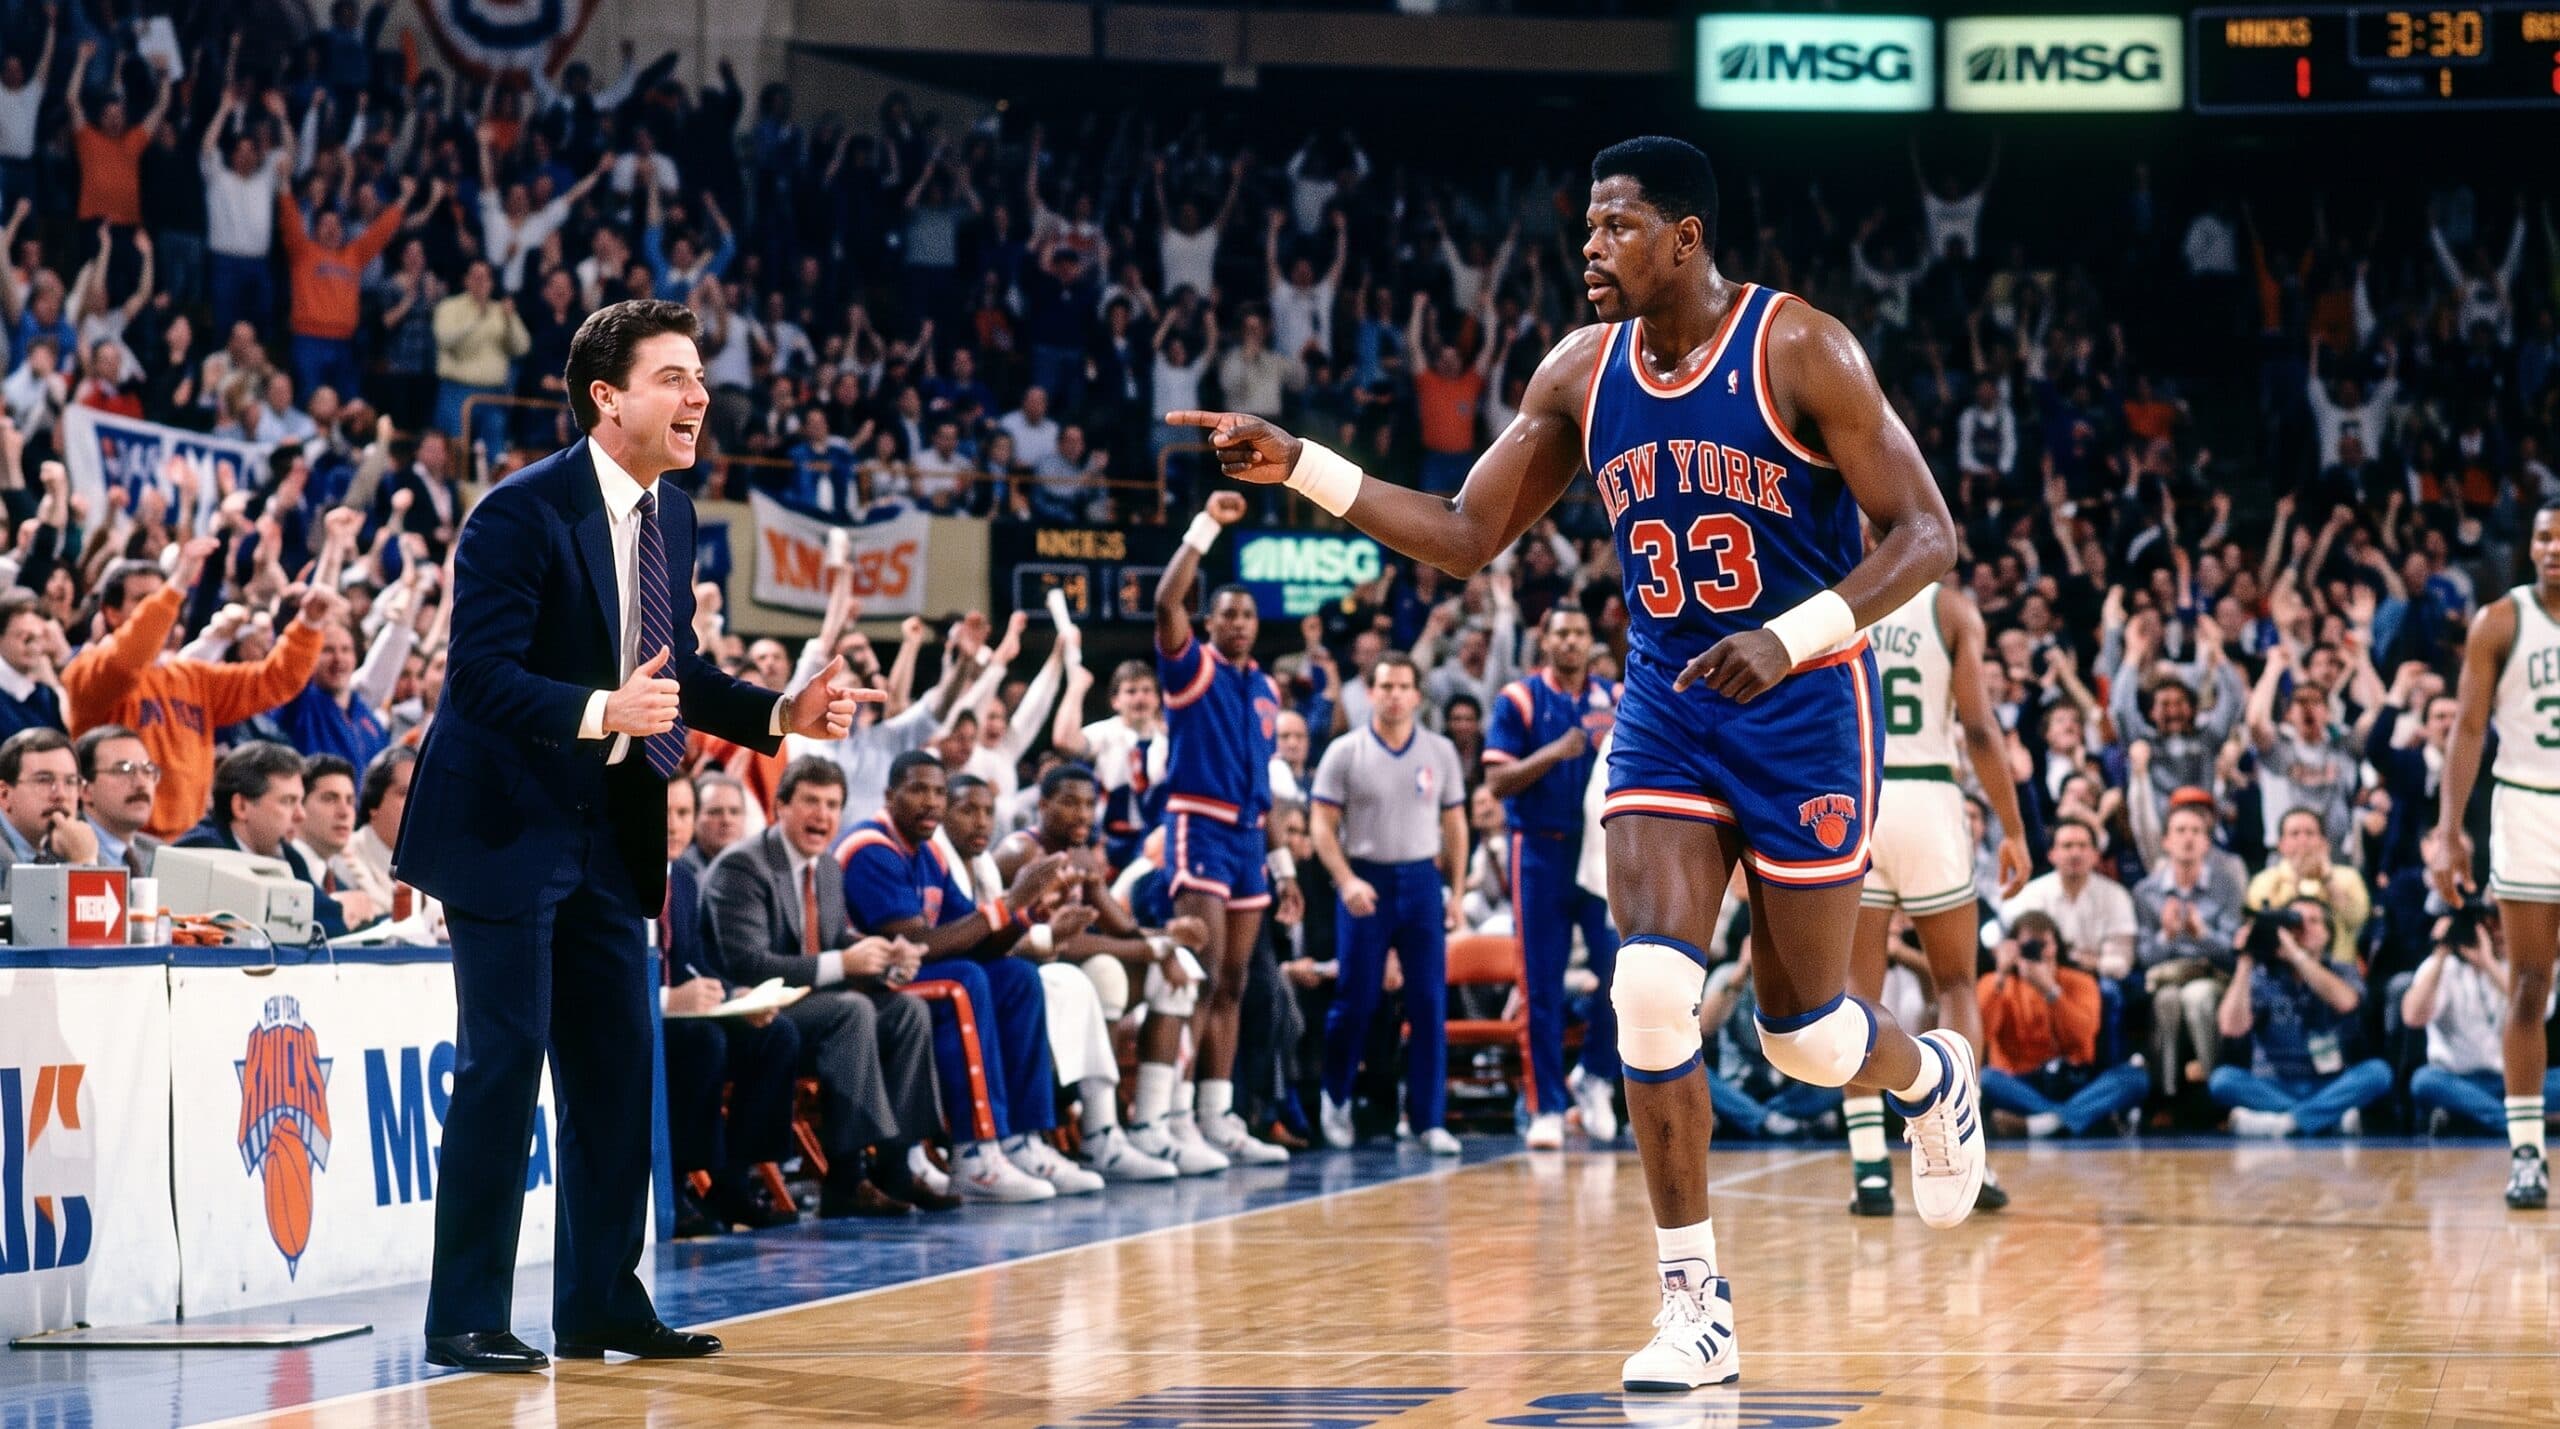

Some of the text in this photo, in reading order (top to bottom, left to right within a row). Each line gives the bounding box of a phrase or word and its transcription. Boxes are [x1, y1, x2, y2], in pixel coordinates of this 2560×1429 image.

[1767, 43, 1913, 82] MSG
[2015, 44, 2162, 82] MSG
[2387, 11, 2483, 57] 3:30
[1596, 439, 1793, 532] NEW YORK
[1281, 538, 1381, 585] MSG
[1629, 512, 1764, 619] 33
[1882, 666, 1923, 735] 6
[239, 1020, 331, 1150] KNICKS
